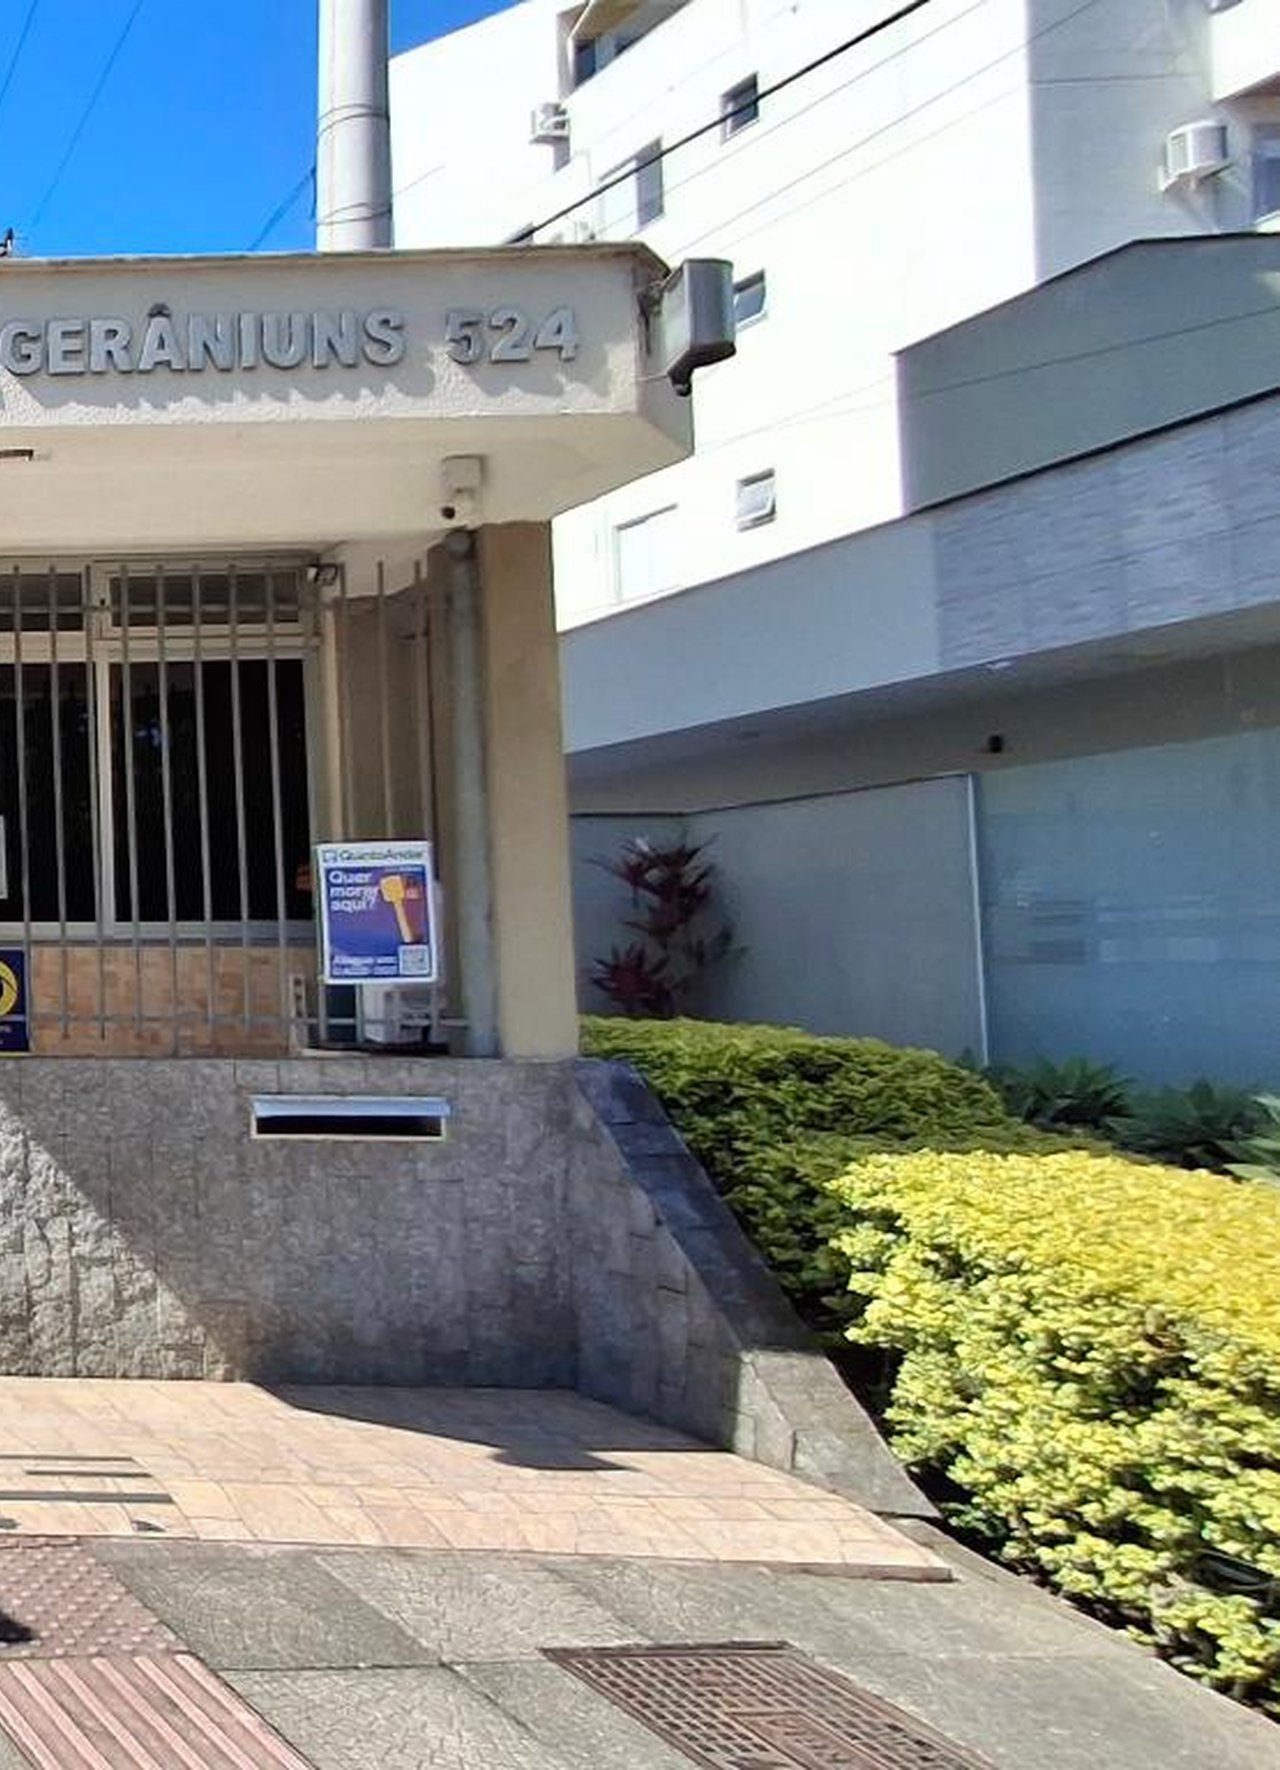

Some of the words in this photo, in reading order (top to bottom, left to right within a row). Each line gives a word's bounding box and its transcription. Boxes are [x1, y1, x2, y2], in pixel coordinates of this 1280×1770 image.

[443, 307, 578, 366] 524
[329, 871, 372, 884] Quer
[331, 899, 375, 913] aqui?
